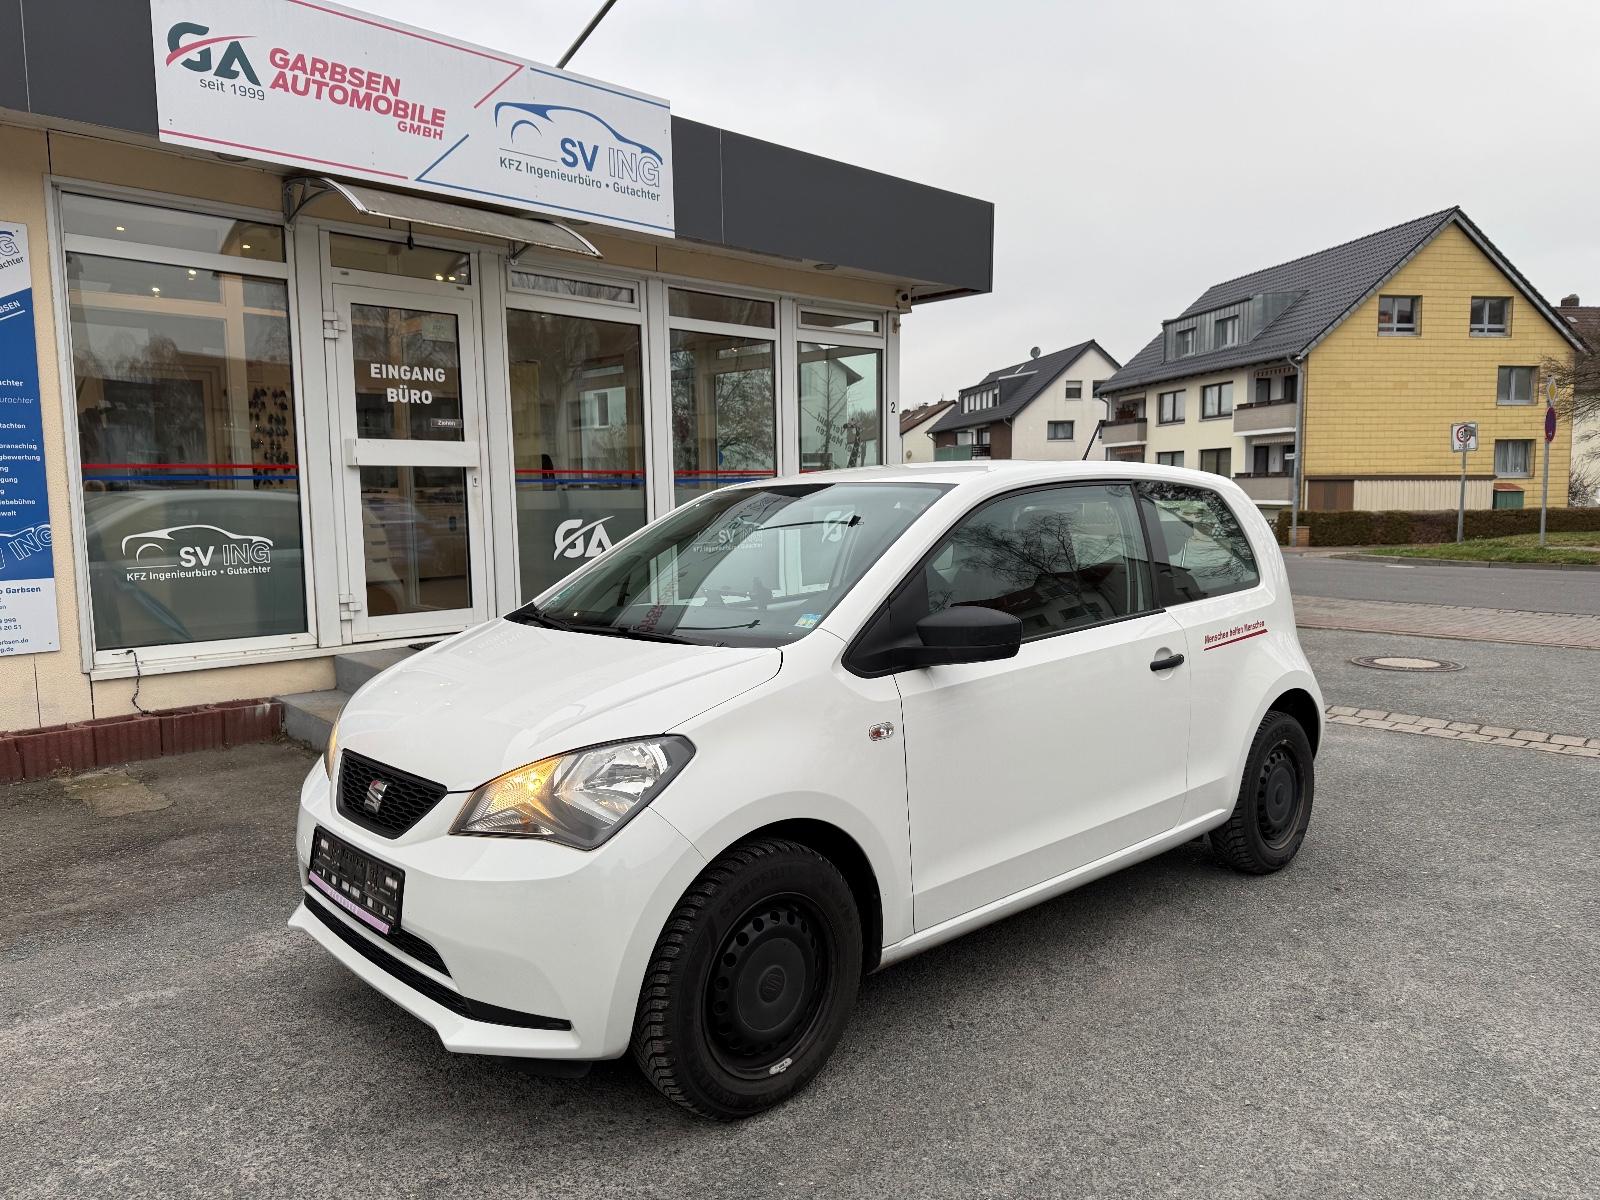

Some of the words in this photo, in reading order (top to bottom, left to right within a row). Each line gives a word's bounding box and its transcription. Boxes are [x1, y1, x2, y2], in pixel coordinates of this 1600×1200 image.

[269, 47, 401, 97] GARBSEN
[199, 78, 226, 92] seit
[230, 83, 265, 101] 1999
[269, 70, 447, 128] AUTOMOBILE
[397, 120, 444, 140] GMBH
[560, 137, 599, 172] SV
[608, 147, 660, 188] ING
[499, 156, 522, 172] KFZ
[525, 162, 601, 189] Ingenieurbüro
[613, 181, 661, 202] Gutachter
[370, 363, 446, 383] EINGANG
[386, 384, 433, 405] BÜRO
[890, 401, 896, 414] 2
[554, 518, 614, 560] GA
[179, 545, 215, 568] SV
[222, 542, 271, 566] ING
[126, 572, 147, 582] KFZ
[149, 568, 217, 581] Ingenieurbüro
[226, 565, 271, 576] Gutachter
